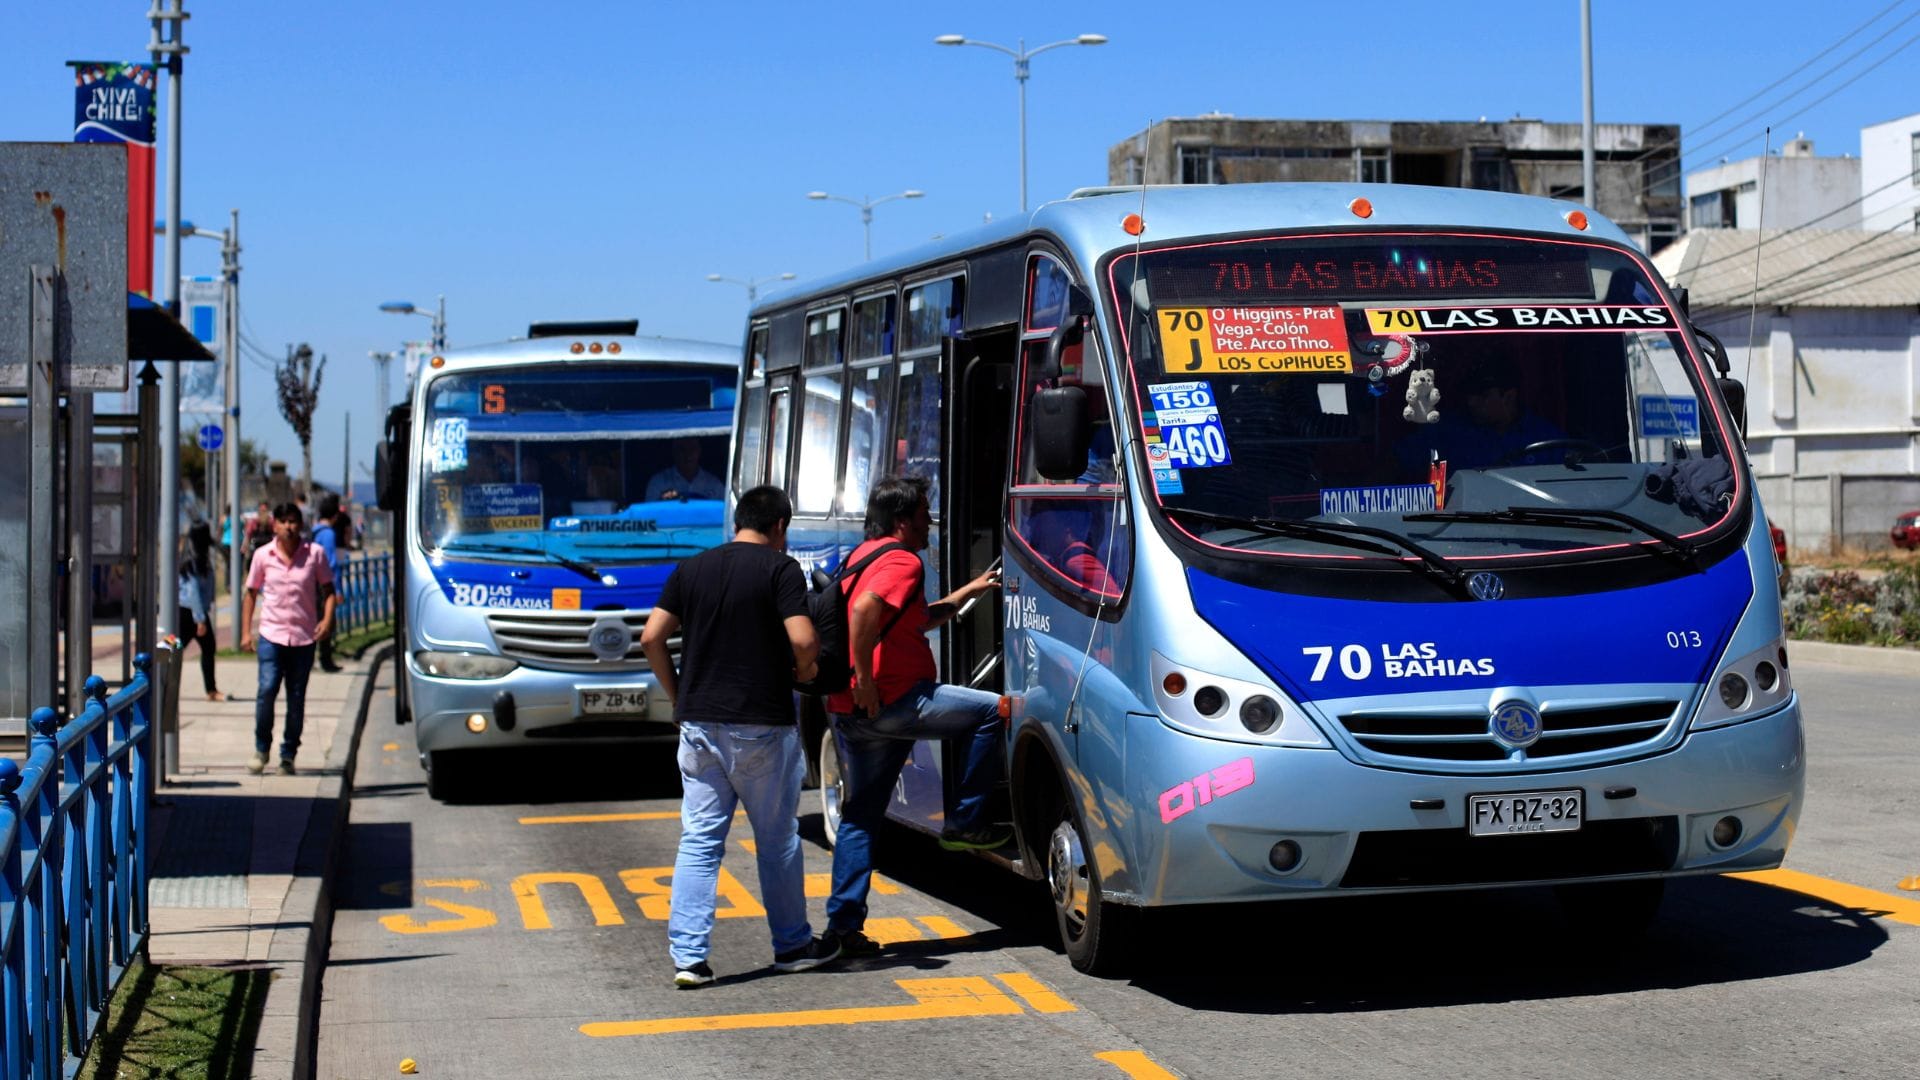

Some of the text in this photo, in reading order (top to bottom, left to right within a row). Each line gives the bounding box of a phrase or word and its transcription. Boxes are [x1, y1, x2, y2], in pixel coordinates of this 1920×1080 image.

[92, 87, 136, 105] ¡VIVA
[86, 103, 142, 121] CHILE!
[1209, 260, 1499, 290] 70 LAS BAHIAS
[1164, 311, 1204, 332] 70
[1233, 308, 1294, 323] Higgins
[1303, 308, 1336, 320] Prat
[1377, 307, 1668, 328] 70 LAS BAHIAS
[1213, 323, 1254, 338] Vega
[1263, 322, 1309, 335] Colón
[1216, 336, 1334, 350] Pte. Arco Thno.
[1185, 338, 1203, 371] J
[1218, 357, 1251, 370] LOS
[1150, 384, 1195, 393] Estudiantes
[484, 384, 505, 414] S
[1155, 390, 1211, 409] 150
[1168, 425, 1226, 466] 460
[490, 497, 539, 508] Autopista
[492, 518, 541, 529] VICENTE
[454, 583, 512, 606] 80 LAS
[488, 597, 550, 609] GALAXIAS
[1005, 595, 1037, 630] 70 LAS
[1023, 612, 1050, 632] BAHIAS
[1667, 631, 1702, 648] 013
[1302, 643, 1437, 682] 70 LAS
[1385, 658, 1495, 678] BAHIAS
[584, 693, 600, 706] FP
[1158, 757, 1255, 824] 013
